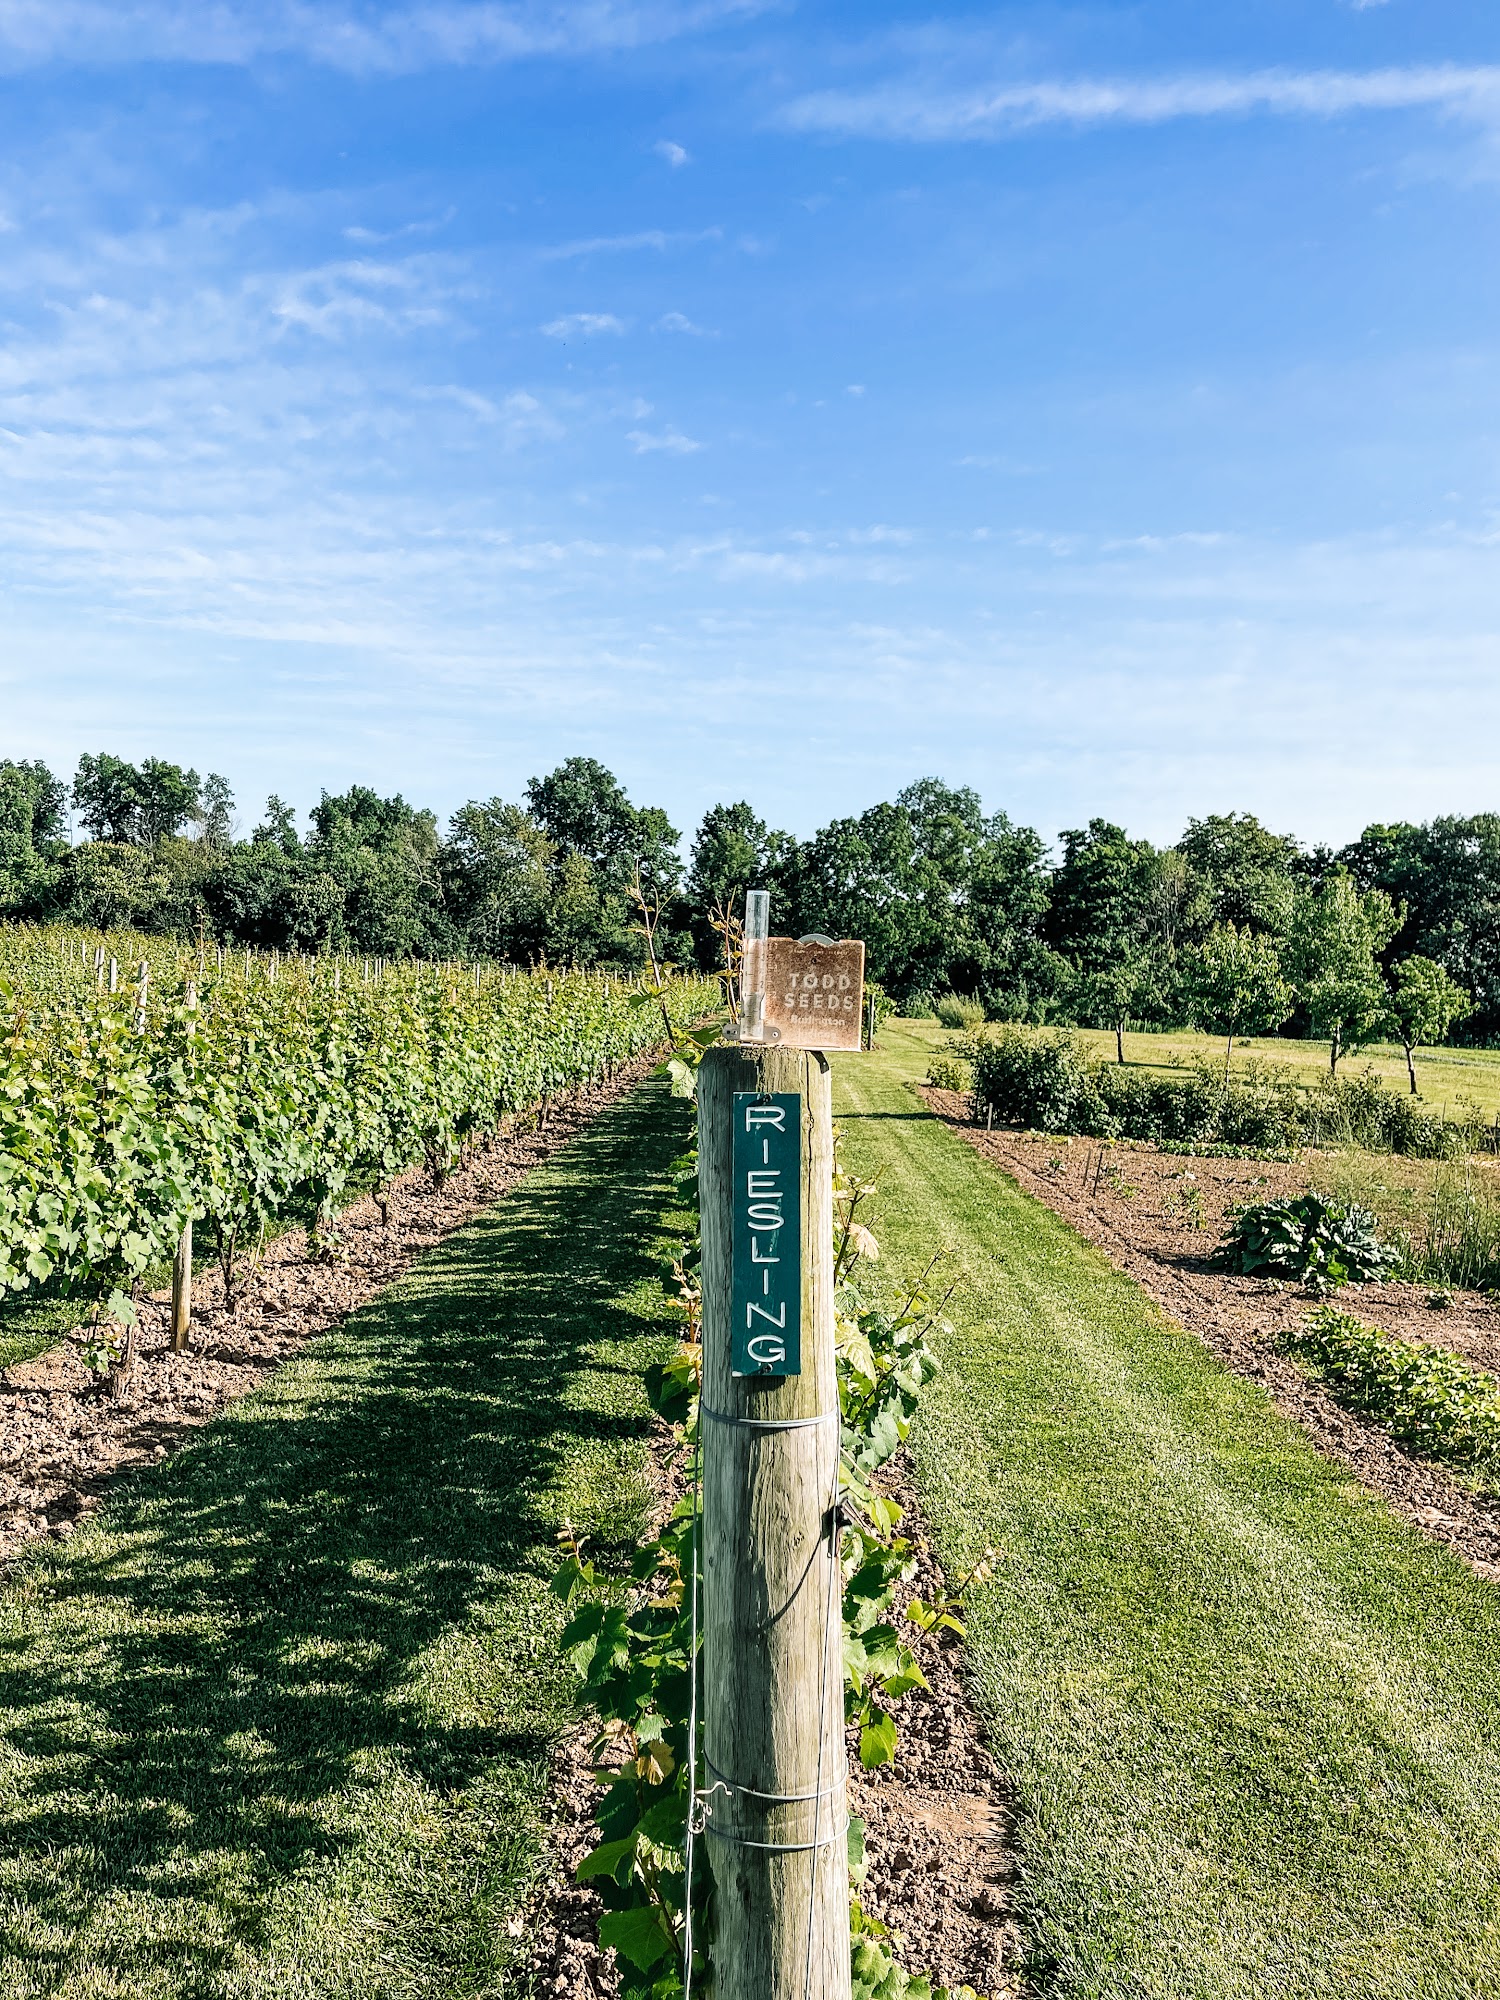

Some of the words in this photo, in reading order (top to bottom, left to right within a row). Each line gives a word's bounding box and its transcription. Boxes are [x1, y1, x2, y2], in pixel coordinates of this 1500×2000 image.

[789, 972, 851, 990] TODD
[784, 992, 854, 1010] SEEDS
[745, 1105, 786, 1363] RIESLING
